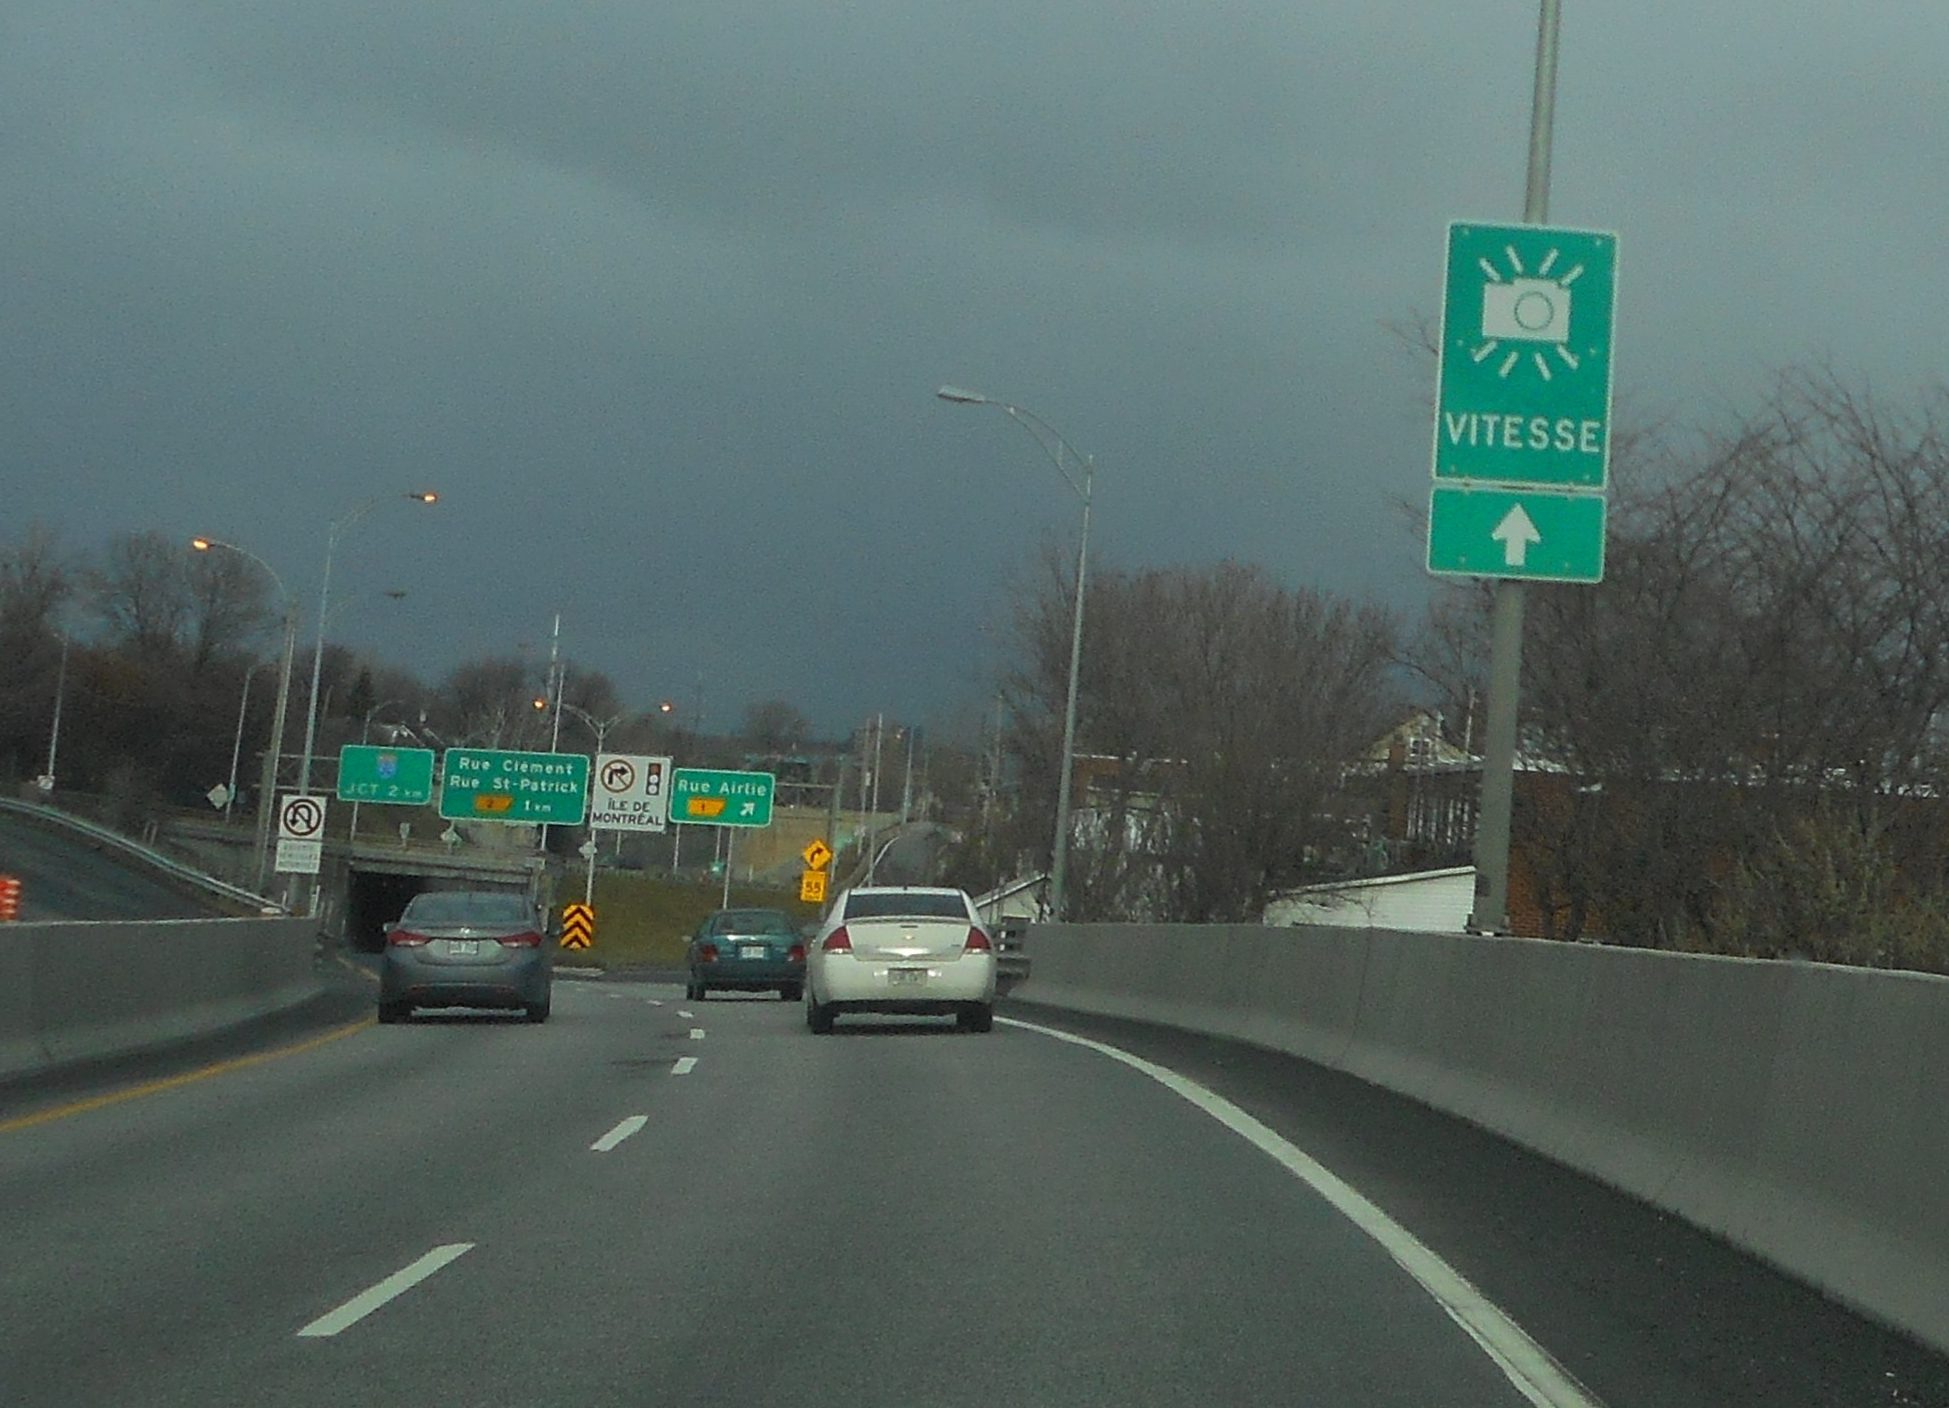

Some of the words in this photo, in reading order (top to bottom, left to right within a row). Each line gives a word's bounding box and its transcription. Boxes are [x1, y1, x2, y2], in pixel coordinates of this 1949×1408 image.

[1445, 411, 1600, 453] VITESSE
[459, 757, 491, 770] Rue
[345, 782, 379, 796] JCT
[388, 784, 399, 797] 2
[450, 775, 480, 788] Rue
[493, 777, 578, 793] St-Patrick
[678, 779, 711, 793] Rue
[719, 782, 767, 797] Airlie
[632, 801, 650, 812] DE
[592, 812, 664, 826] MONTRÉAL
